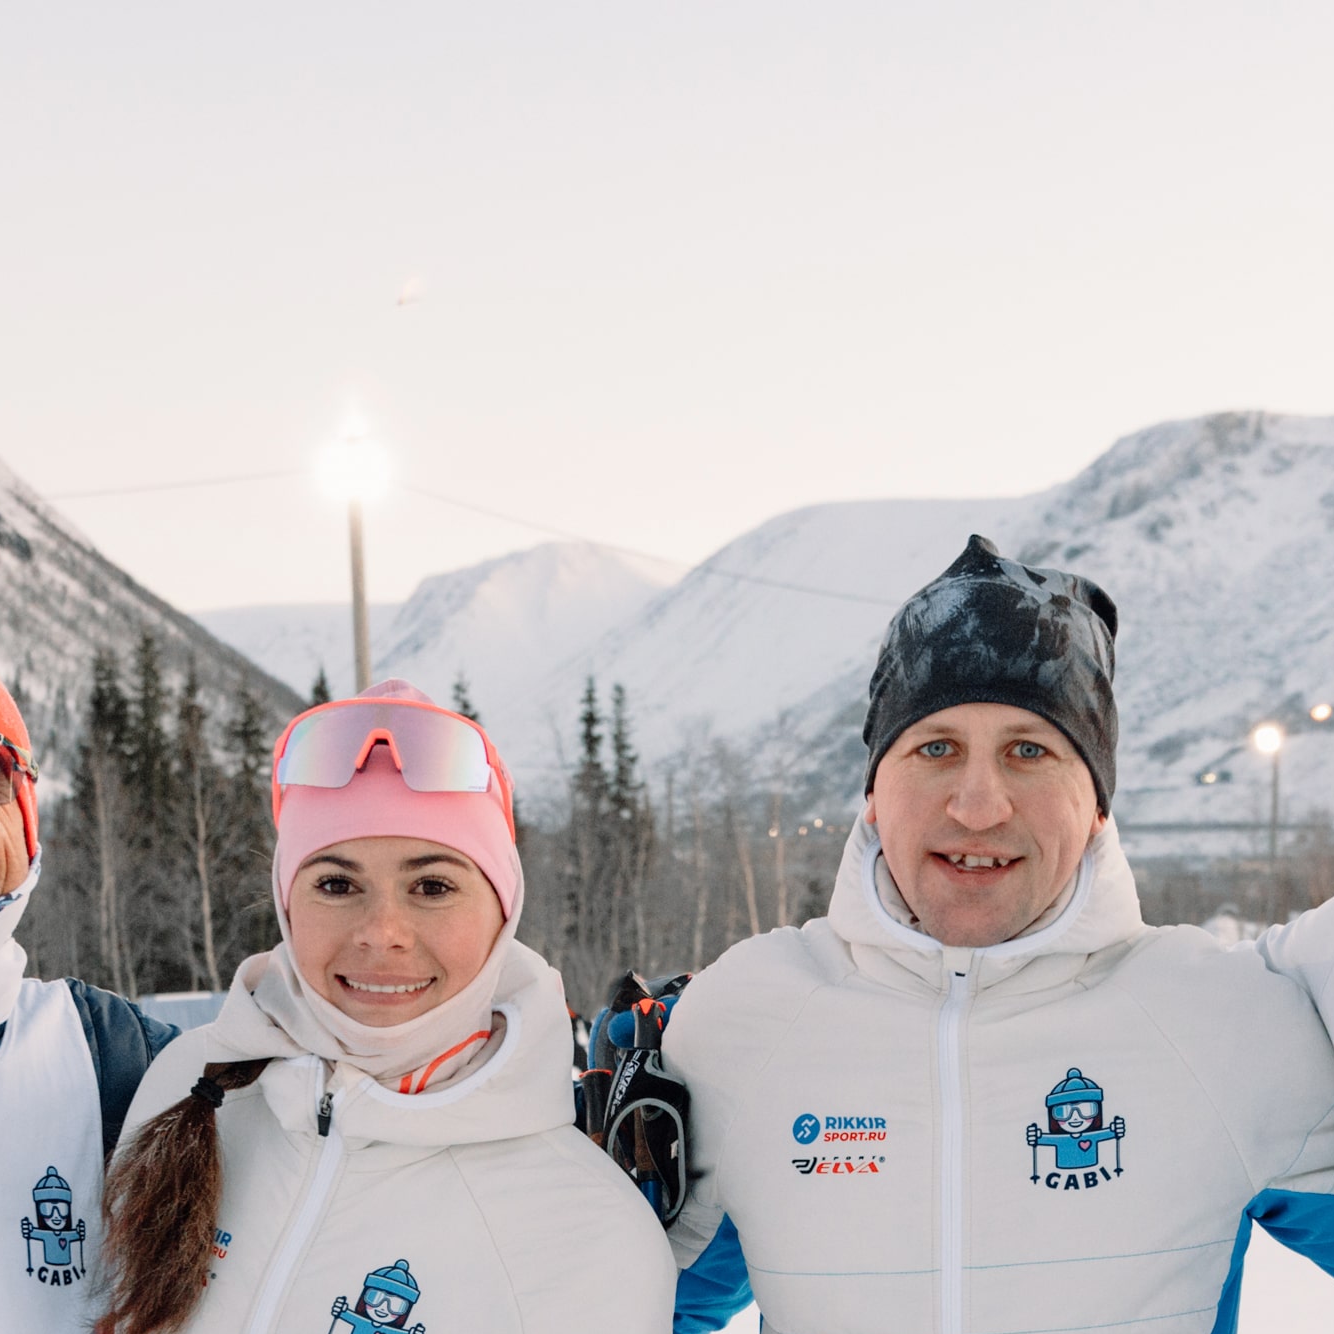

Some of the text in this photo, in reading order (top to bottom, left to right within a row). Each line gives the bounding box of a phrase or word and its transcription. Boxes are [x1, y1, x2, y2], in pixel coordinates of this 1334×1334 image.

[825, 1116, 887, 1130] RIKKIR
[823, 1131, 887, 1142] SPORT.RU
[1045, 1169, 1111, 1191] GABI
[37, 1266, 81, 1287] GABI
